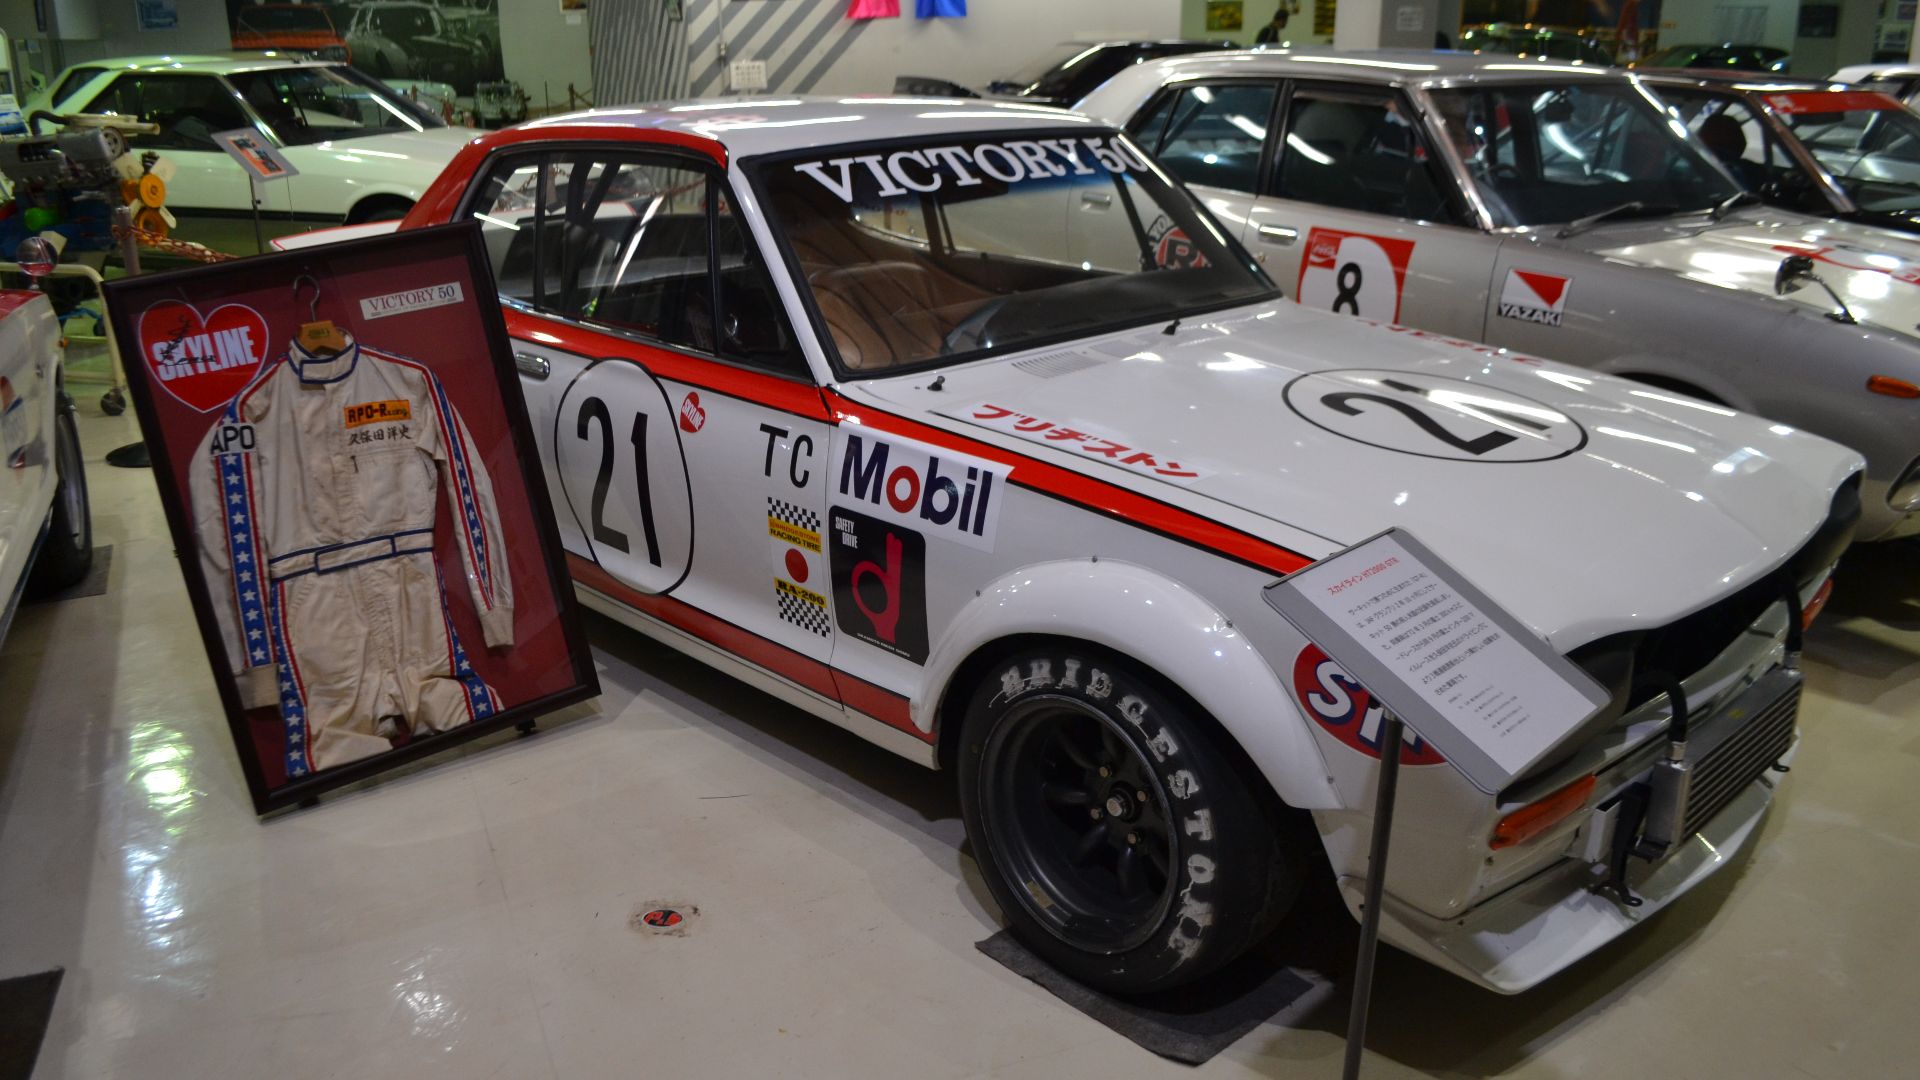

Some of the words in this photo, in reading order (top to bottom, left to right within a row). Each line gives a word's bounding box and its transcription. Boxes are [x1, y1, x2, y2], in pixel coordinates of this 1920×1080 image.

[794, 138, 1095, 203] VICTORY
[1087, 137, 1149, 173] 50
[368, 287, 435, 312] VICTORY
[438, 284, 456, 300] 50
[1332, 262, 1362, 316] 8
[1500, 304, 1561, 327] YAZAKI
[152, 326, 259, 381] SKYLINE
[1320, 378, 1551, 456] 21
[210, 425, 256, 454] APO
[972, 404, 1198, 477] ブリヂストン
[577, 396, 662, 568] 21
[839, 435, 994, 537] Mobil
[835, 516, 855, 533] SAFETY
[770, 529, 801, 545] RACING
[802, 540, 821, 553] TIRE
[842, 532, 858, 549] DRIVE
[777, 581, 825, 607] RA-200
[1328, 575, 1362, 596] スカイライン
